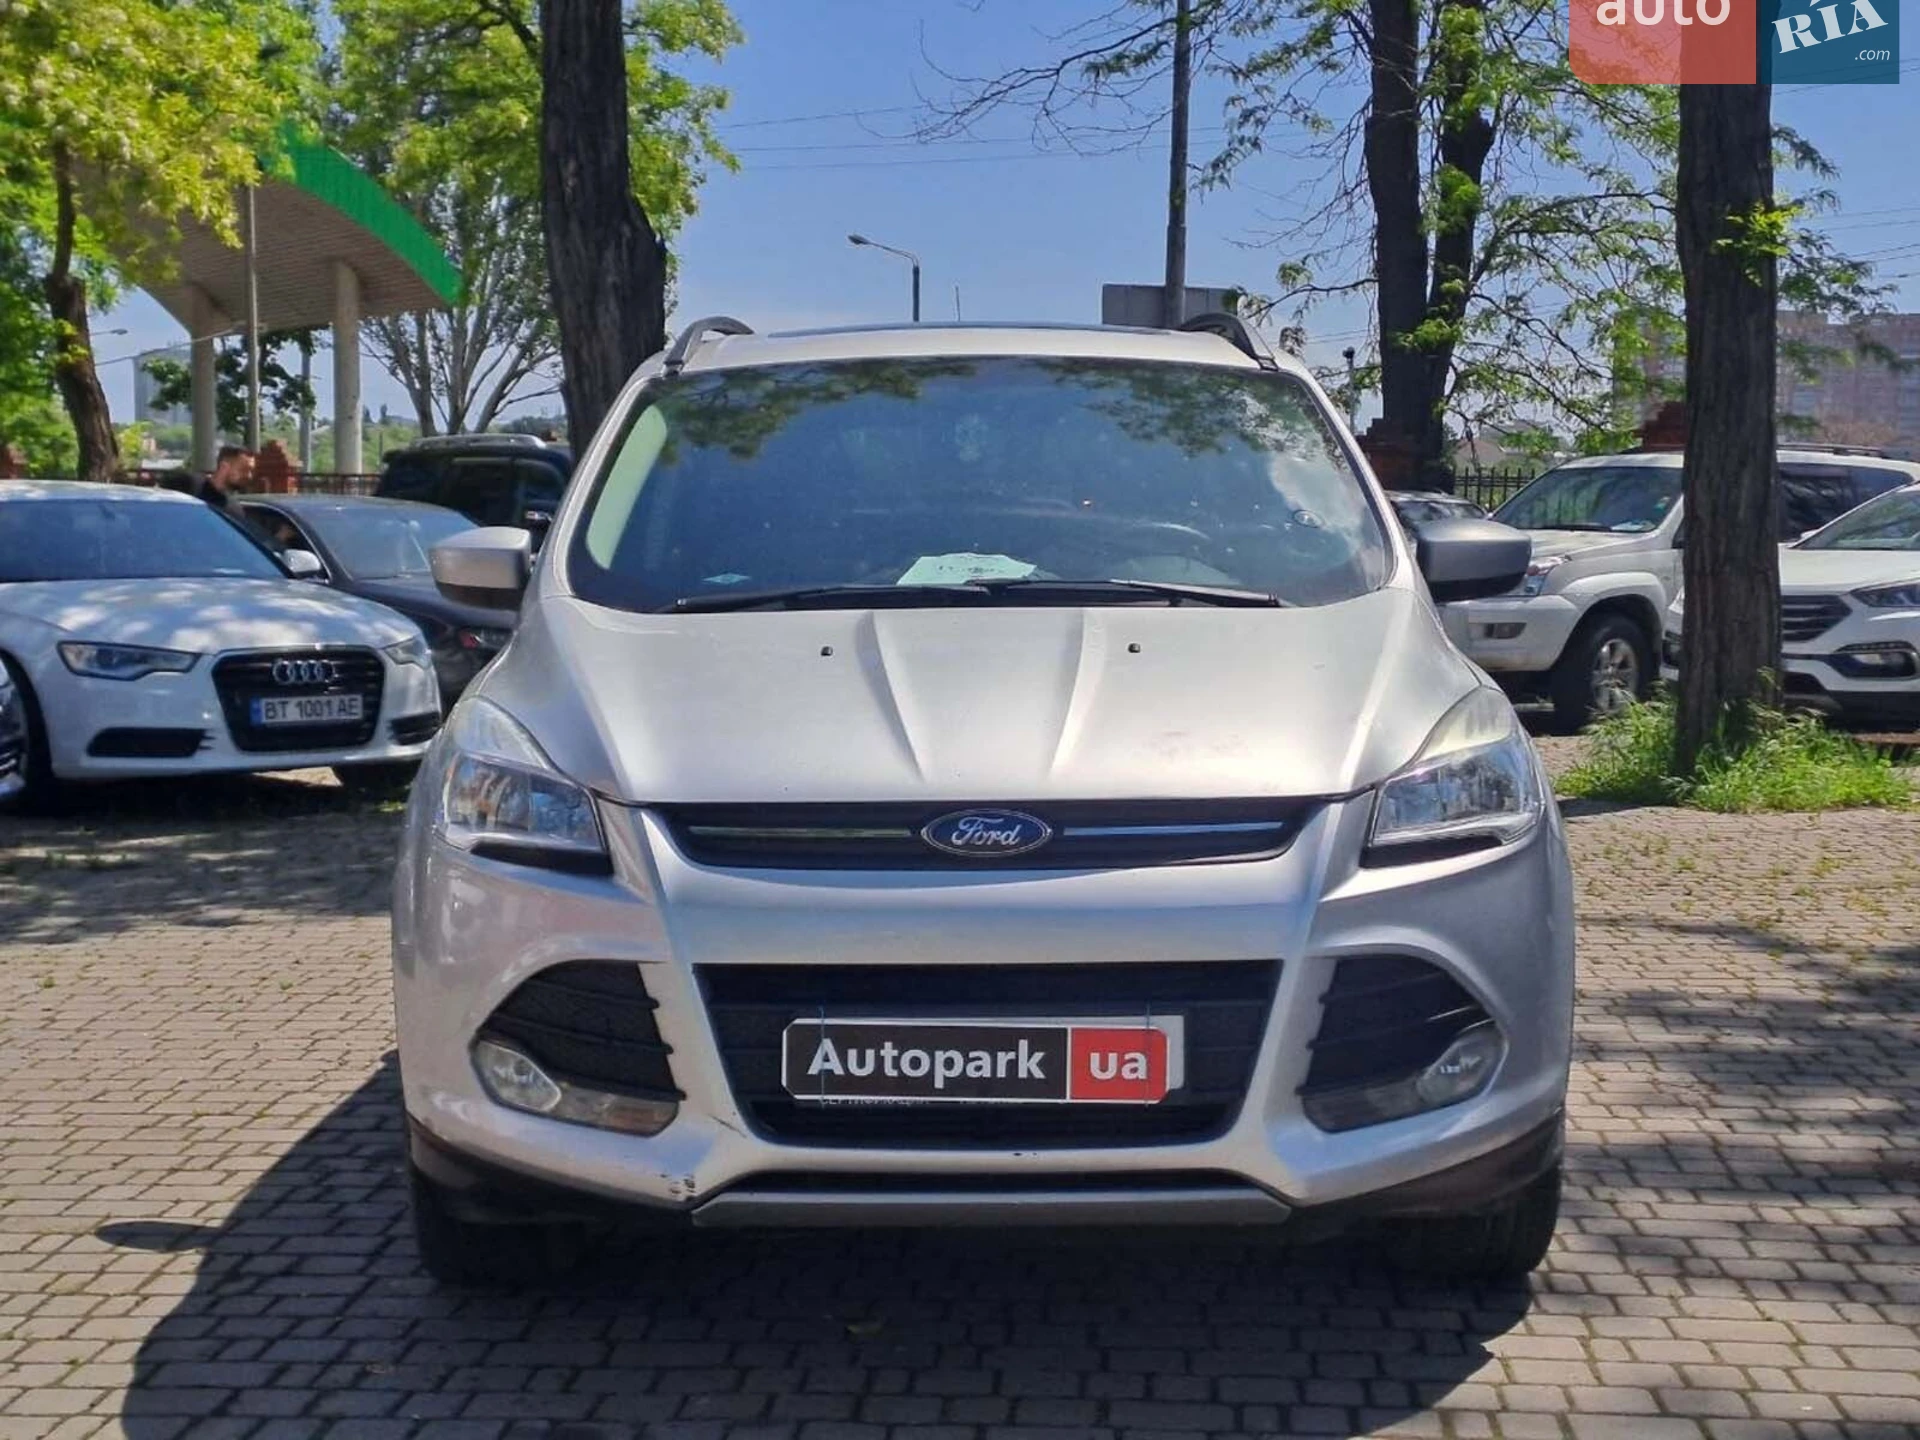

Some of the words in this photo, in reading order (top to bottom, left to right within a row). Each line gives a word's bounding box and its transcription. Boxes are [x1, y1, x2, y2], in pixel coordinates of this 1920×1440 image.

[265, 702, 288, 720] BT
[295, 698, 332, 718] 1001
[338, 697, 359, 716] AE
[951, 816, 1022, 846] Ford
[807, 1038, 1046, 1089] Autopark
[1089, 1051, 1148, 1080] ua
